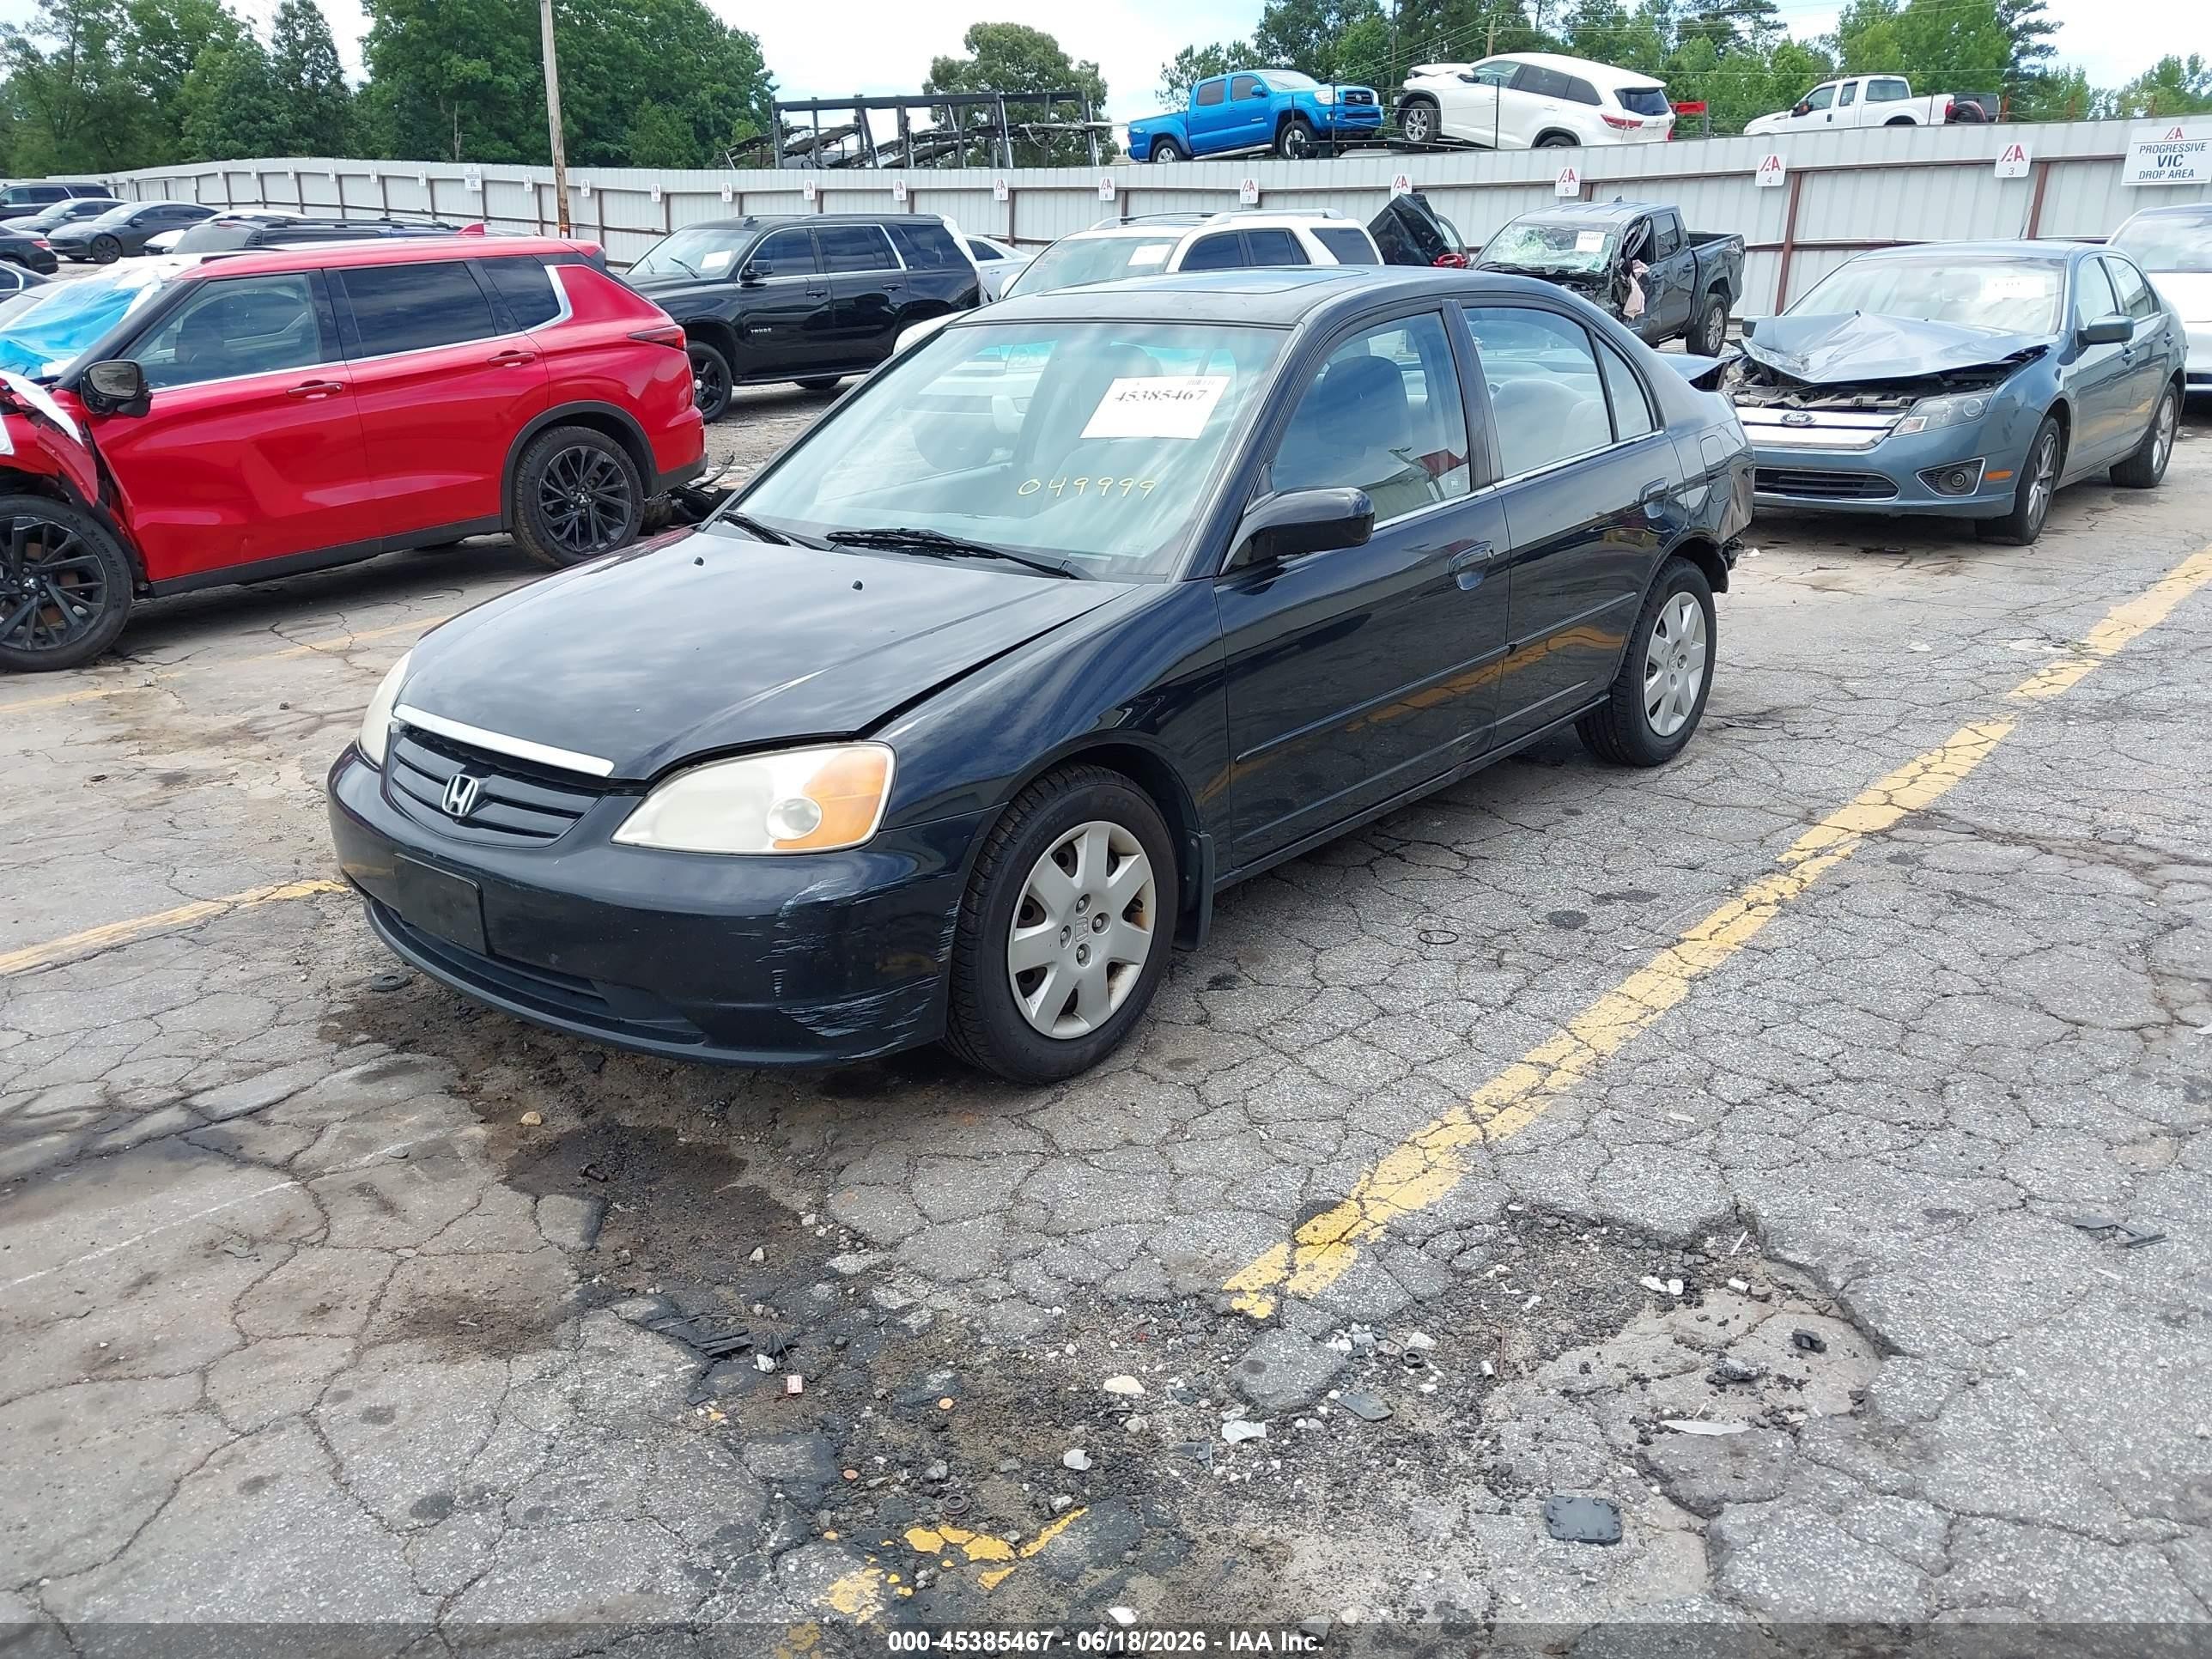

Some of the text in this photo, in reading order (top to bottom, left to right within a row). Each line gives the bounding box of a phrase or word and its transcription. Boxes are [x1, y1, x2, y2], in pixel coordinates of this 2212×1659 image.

[2139, 142, 2208, 155] PROGRESSIVE
[2157, 154, 2184, 167] VIC
[2008, 167, 2014, 175] 3
[2138, 168, 2194, 179] DROP AREA
[1766, 176, 1772, 185] 4
[1115, 389, 1208, 402] 45385467
[1017, 477, 1158, 501] 049999
